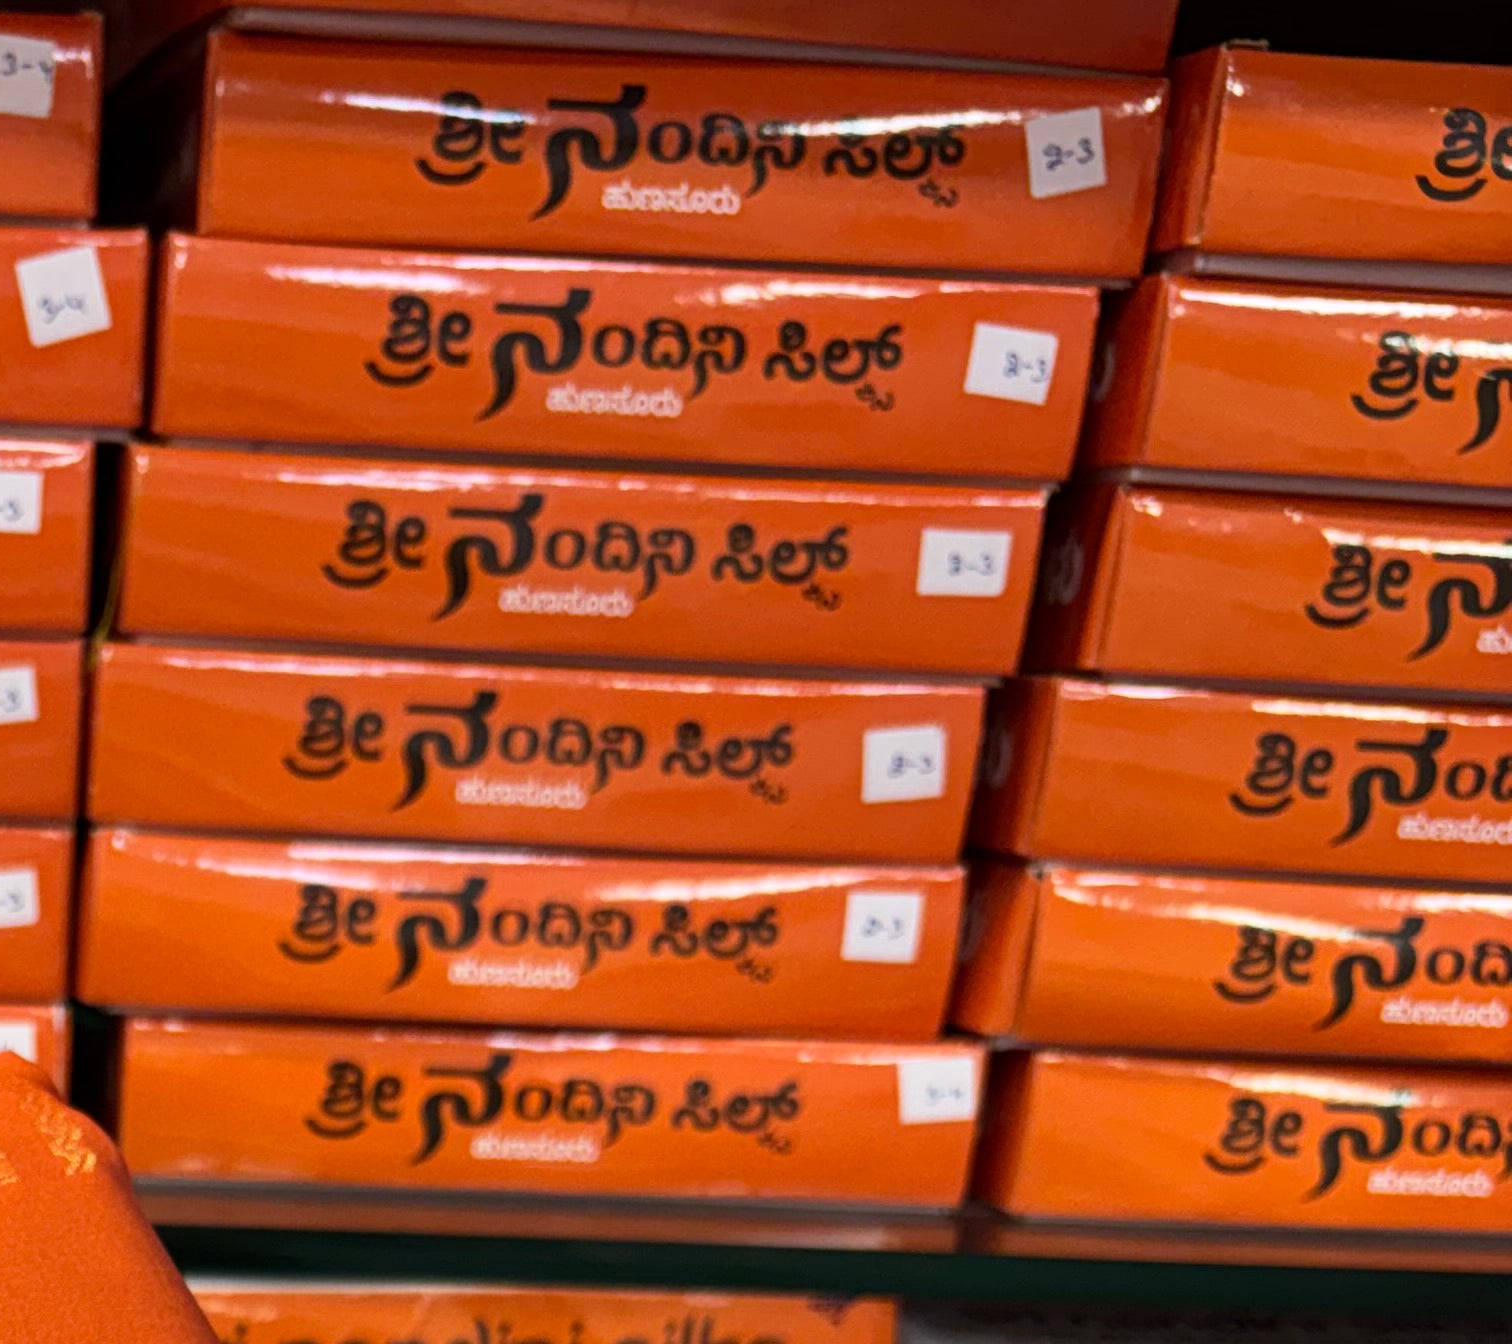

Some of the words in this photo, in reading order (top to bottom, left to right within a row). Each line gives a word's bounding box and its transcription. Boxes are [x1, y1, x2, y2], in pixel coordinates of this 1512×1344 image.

[416, 88, 527, 185] ಶ್ರೀ
[535, 82, 808, 218] ನಂದಿನಿ
[603, 180, 740, 214] ಹುಣಸೂರು
[365, 294, 472, 387] ಶ್ರೀ
[479, 288, 747, 420] ನಂದಿನಿ
[763, 320, 902, 410] ಸಿಲ್ಕ್ಸ್
[1351, 331, 1459, 420] ಶ್ರೀ
[322, 499, 427, 589] ಶ್ರೀ
[436, 493, 696, 619] ನಂದಿನಿ
[712, 523, 849, 610] ಸಿಲ್ಕ್ಸ್
[1306, 545, 1411, 629] ಶ್ರೀ
[283, 695, 385, 780] ಶ್ರೀ
[396, 690, 646, 808] ನಂದಿನಿ
[661, 720, 794, 802] ಸಿಲ್ಕ್ಸ್
[1229, 732, 1334, 816] ಶ್ರೀ
[279, 884, 377, 963] ಶ್ರೀ
[389, 876, 635, 990] ನಂದಿನಿ
[651, 903, 779, 981] ಸಿಲ್ಕ್ಸ್
[1214, 926, 1315, 1004] ಶ್ರೀ
[305, 1059, 403, 1139] ಶ್ರೀ
[412, 1051, 656, 1165] ನಂದಿನಿ
[672, 1079, 800, 1153] ಸಿಲ್ಕ್ಸ್
[1204, 1096, 1303, 1174] ಶ್ರೀ
